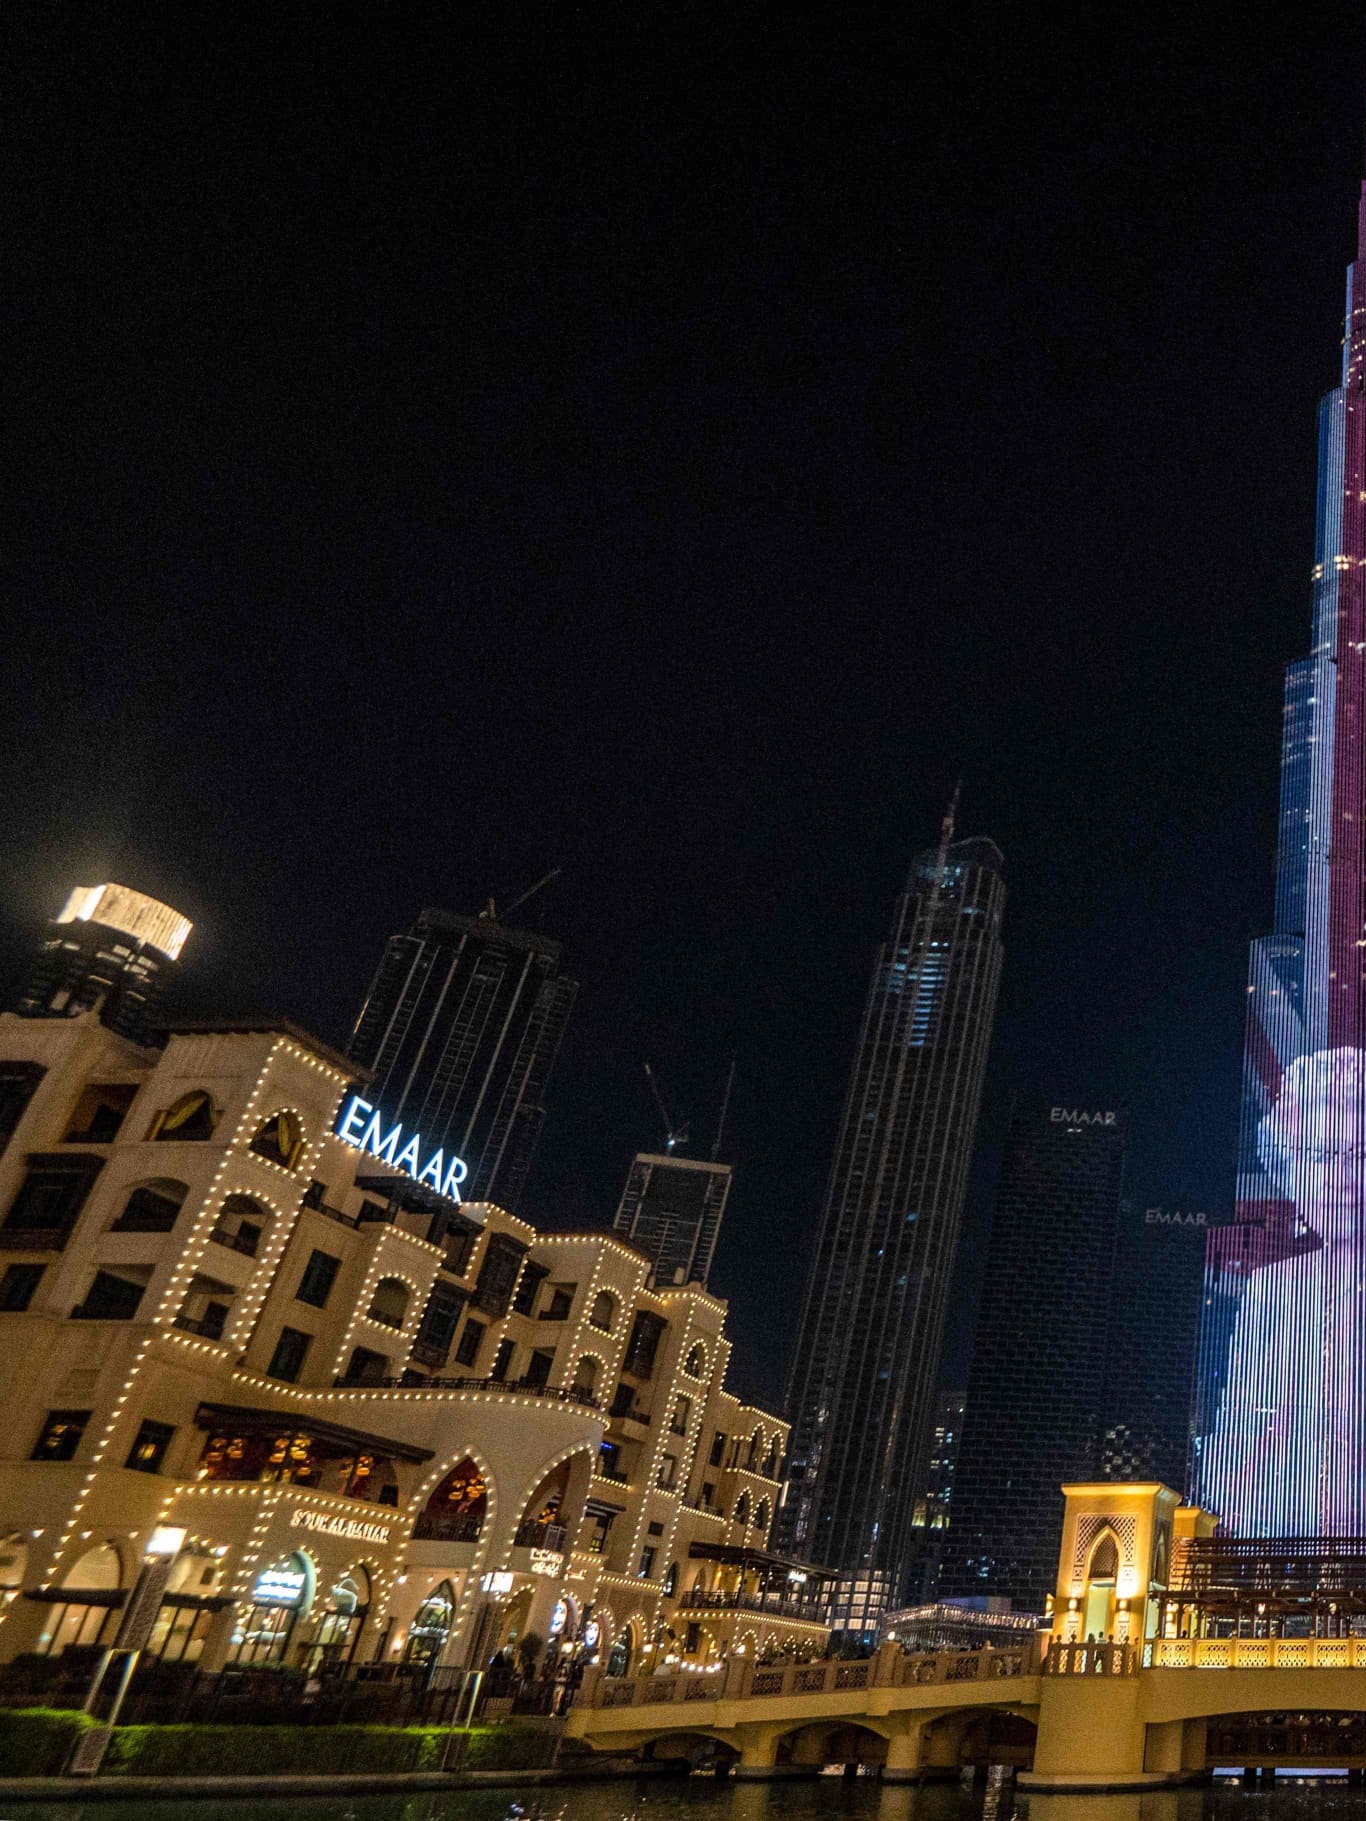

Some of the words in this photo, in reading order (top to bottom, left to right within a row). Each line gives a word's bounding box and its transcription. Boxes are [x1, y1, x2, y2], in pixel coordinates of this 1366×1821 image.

[1050, 1107, 1116, 1126] EMAAR
[339, 1095, 468, 1203] EMAAR
[1145, 1209, 1209, 1227] EMAAR
